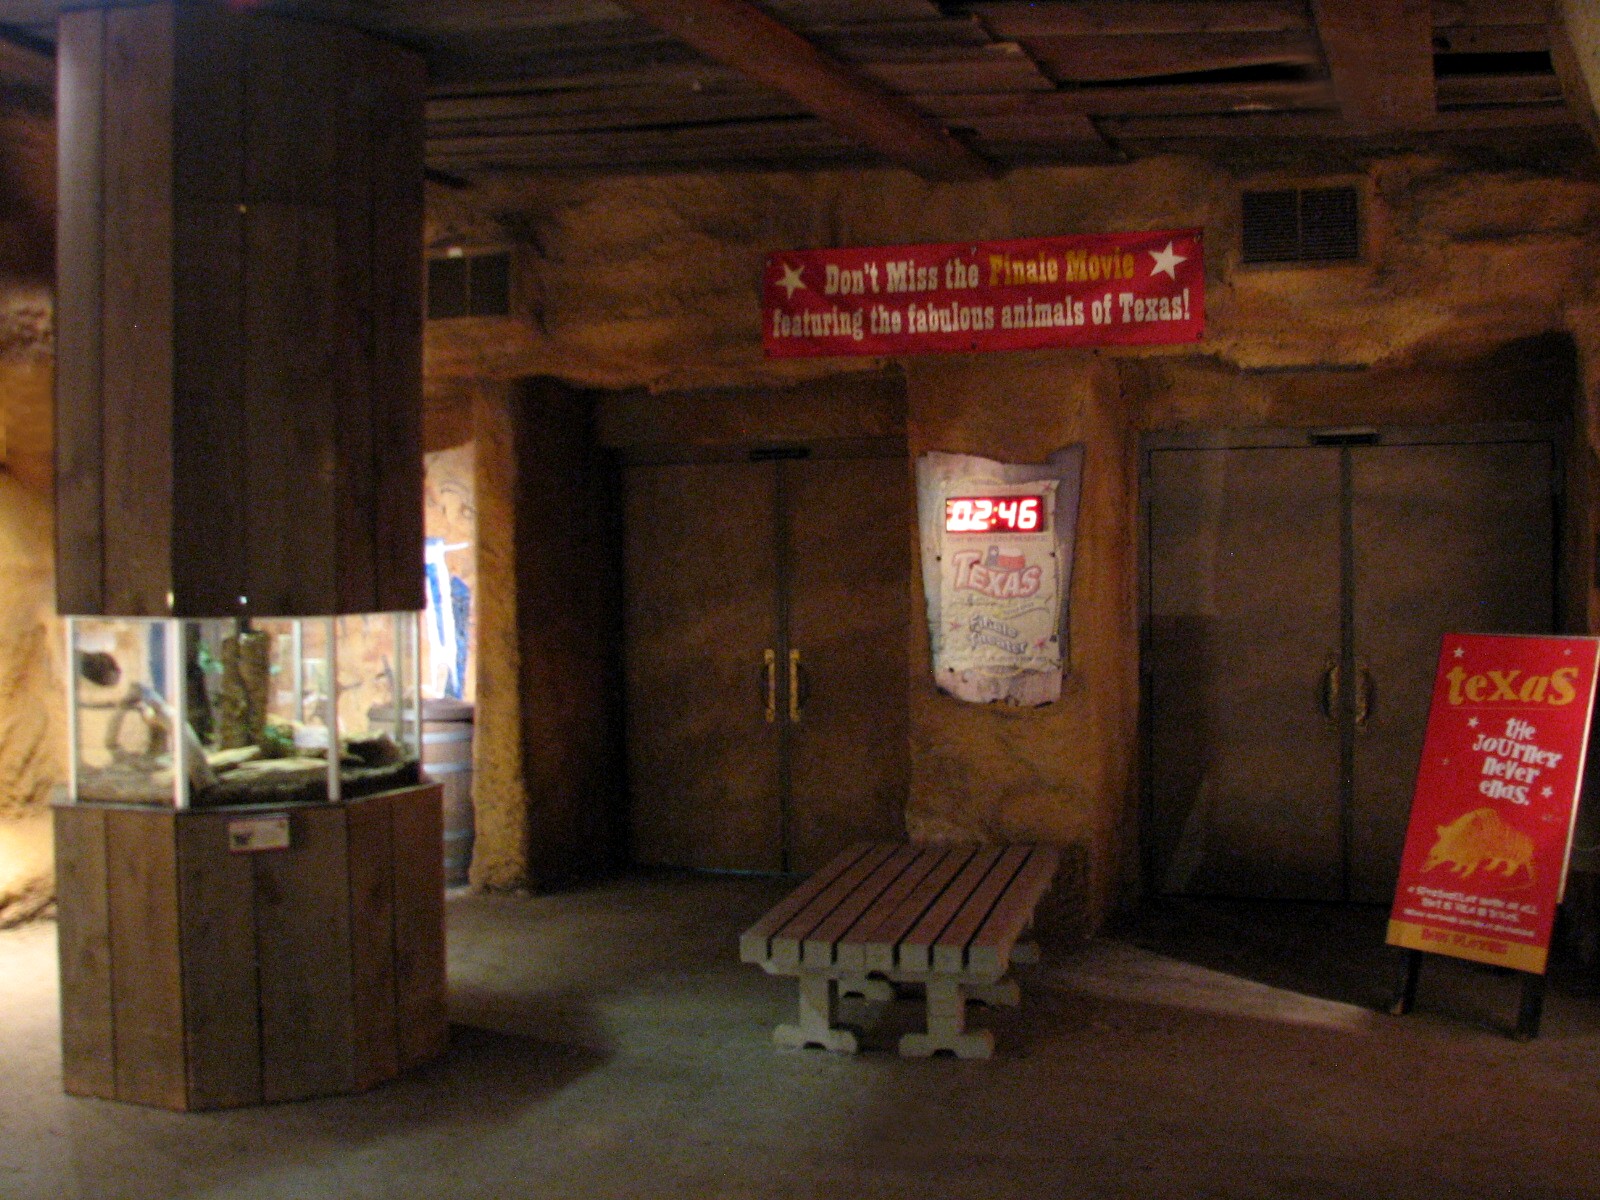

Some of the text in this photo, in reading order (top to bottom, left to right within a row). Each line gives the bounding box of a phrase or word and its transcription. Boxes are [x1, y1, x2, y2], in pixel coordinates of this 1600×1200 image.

[825, 247, 1135, 294] Don't Miss the Finale Movie
[773, 288, 1190, 341] featuring the fabulous animals of Texas!
